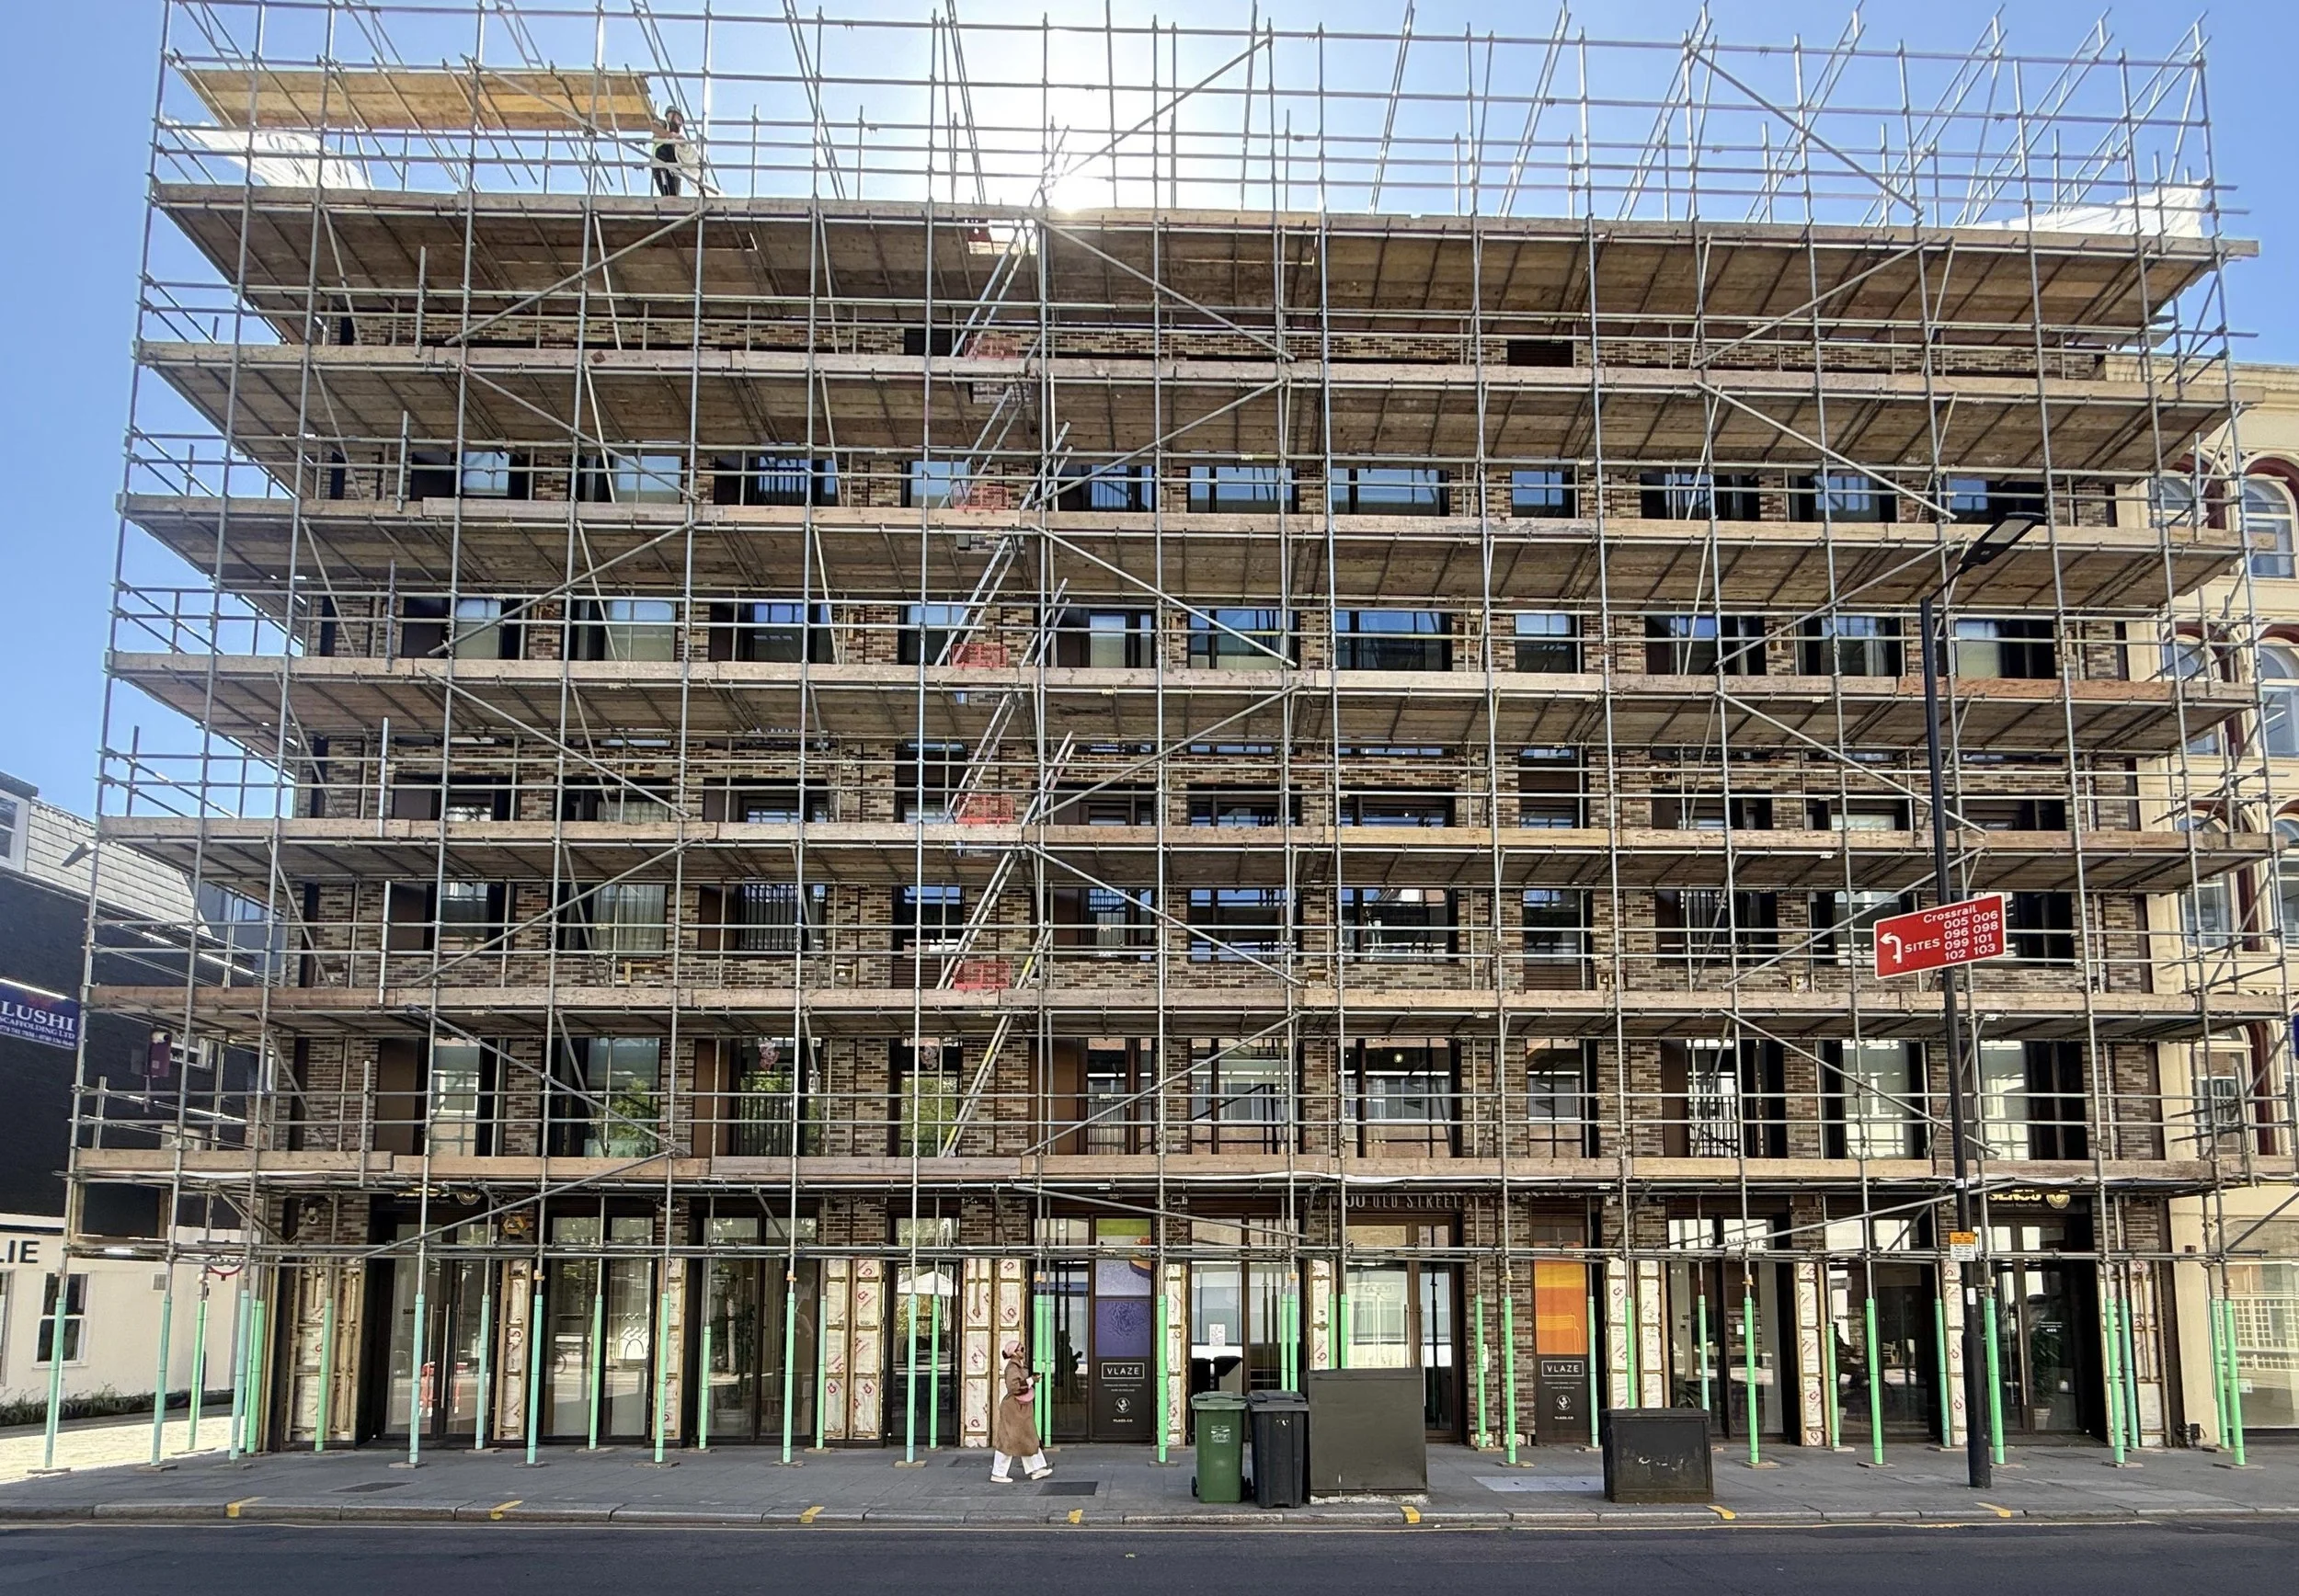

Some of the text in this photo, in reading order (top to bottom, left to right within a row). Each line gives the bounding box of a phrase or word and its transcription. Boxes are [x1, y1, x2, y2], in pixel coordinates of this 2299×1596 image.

[1924, 905, 1977, 923] Crossrail
[1944, 910, 1998, 930] 005 006
[1944, 921, 1998, 940] 096 098
[1904, 938, 1940, 953] SITES
[1944, 932, 1993, 951] 099 101
[1945, 943, 1996, 961] 102 103
[1, 1000, 74, 1032] LUSHI
[59, 1030, 75, 1040] LTD
[1407, 1195, 1459, 1208] STREET
[0, 1239, 40, 1264] IE
[1106, 1367, 1139, 1375] VLAZE
[1547, 1364, 1579, 1373] VLAZE
